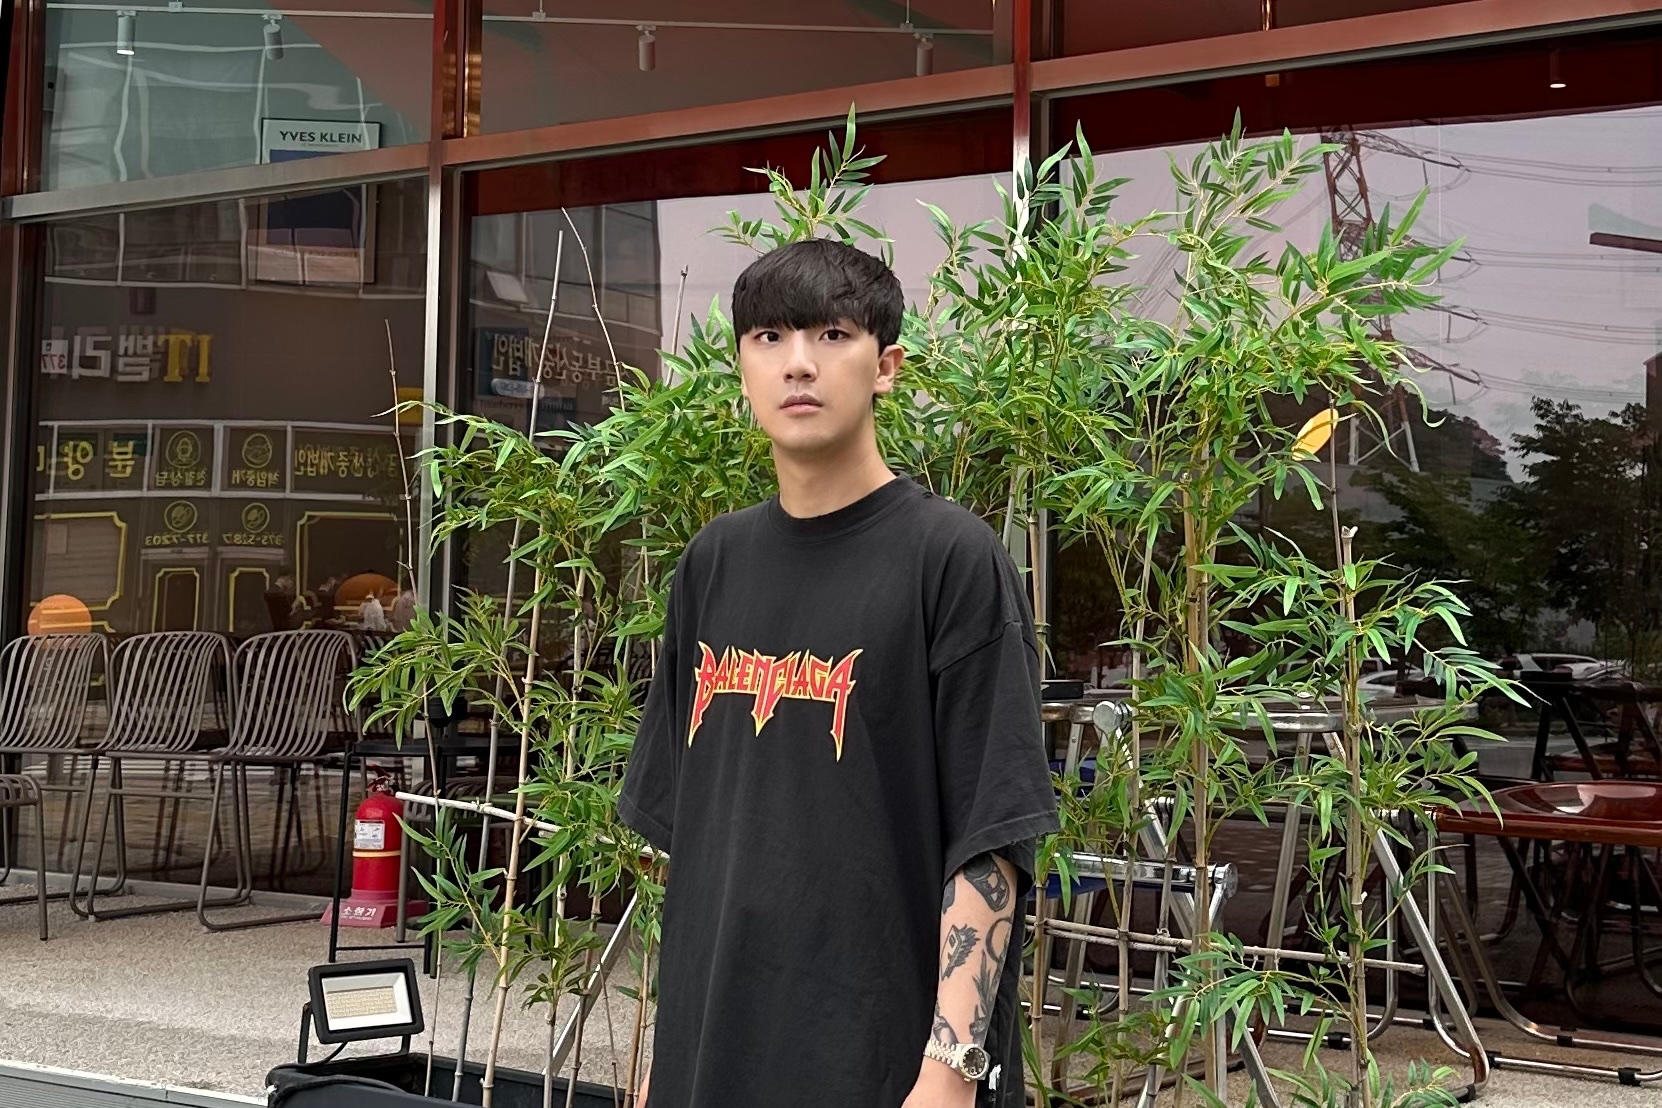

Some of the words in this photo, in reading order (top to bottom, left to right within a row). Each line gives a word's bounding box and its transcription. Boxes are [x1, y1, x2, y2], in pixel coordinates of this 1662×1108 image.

[279, 130, 316, 142] YVES
[320, 131, 362, 144] KLEIN
[687, 640, 864, 763] BALENCIAGA
